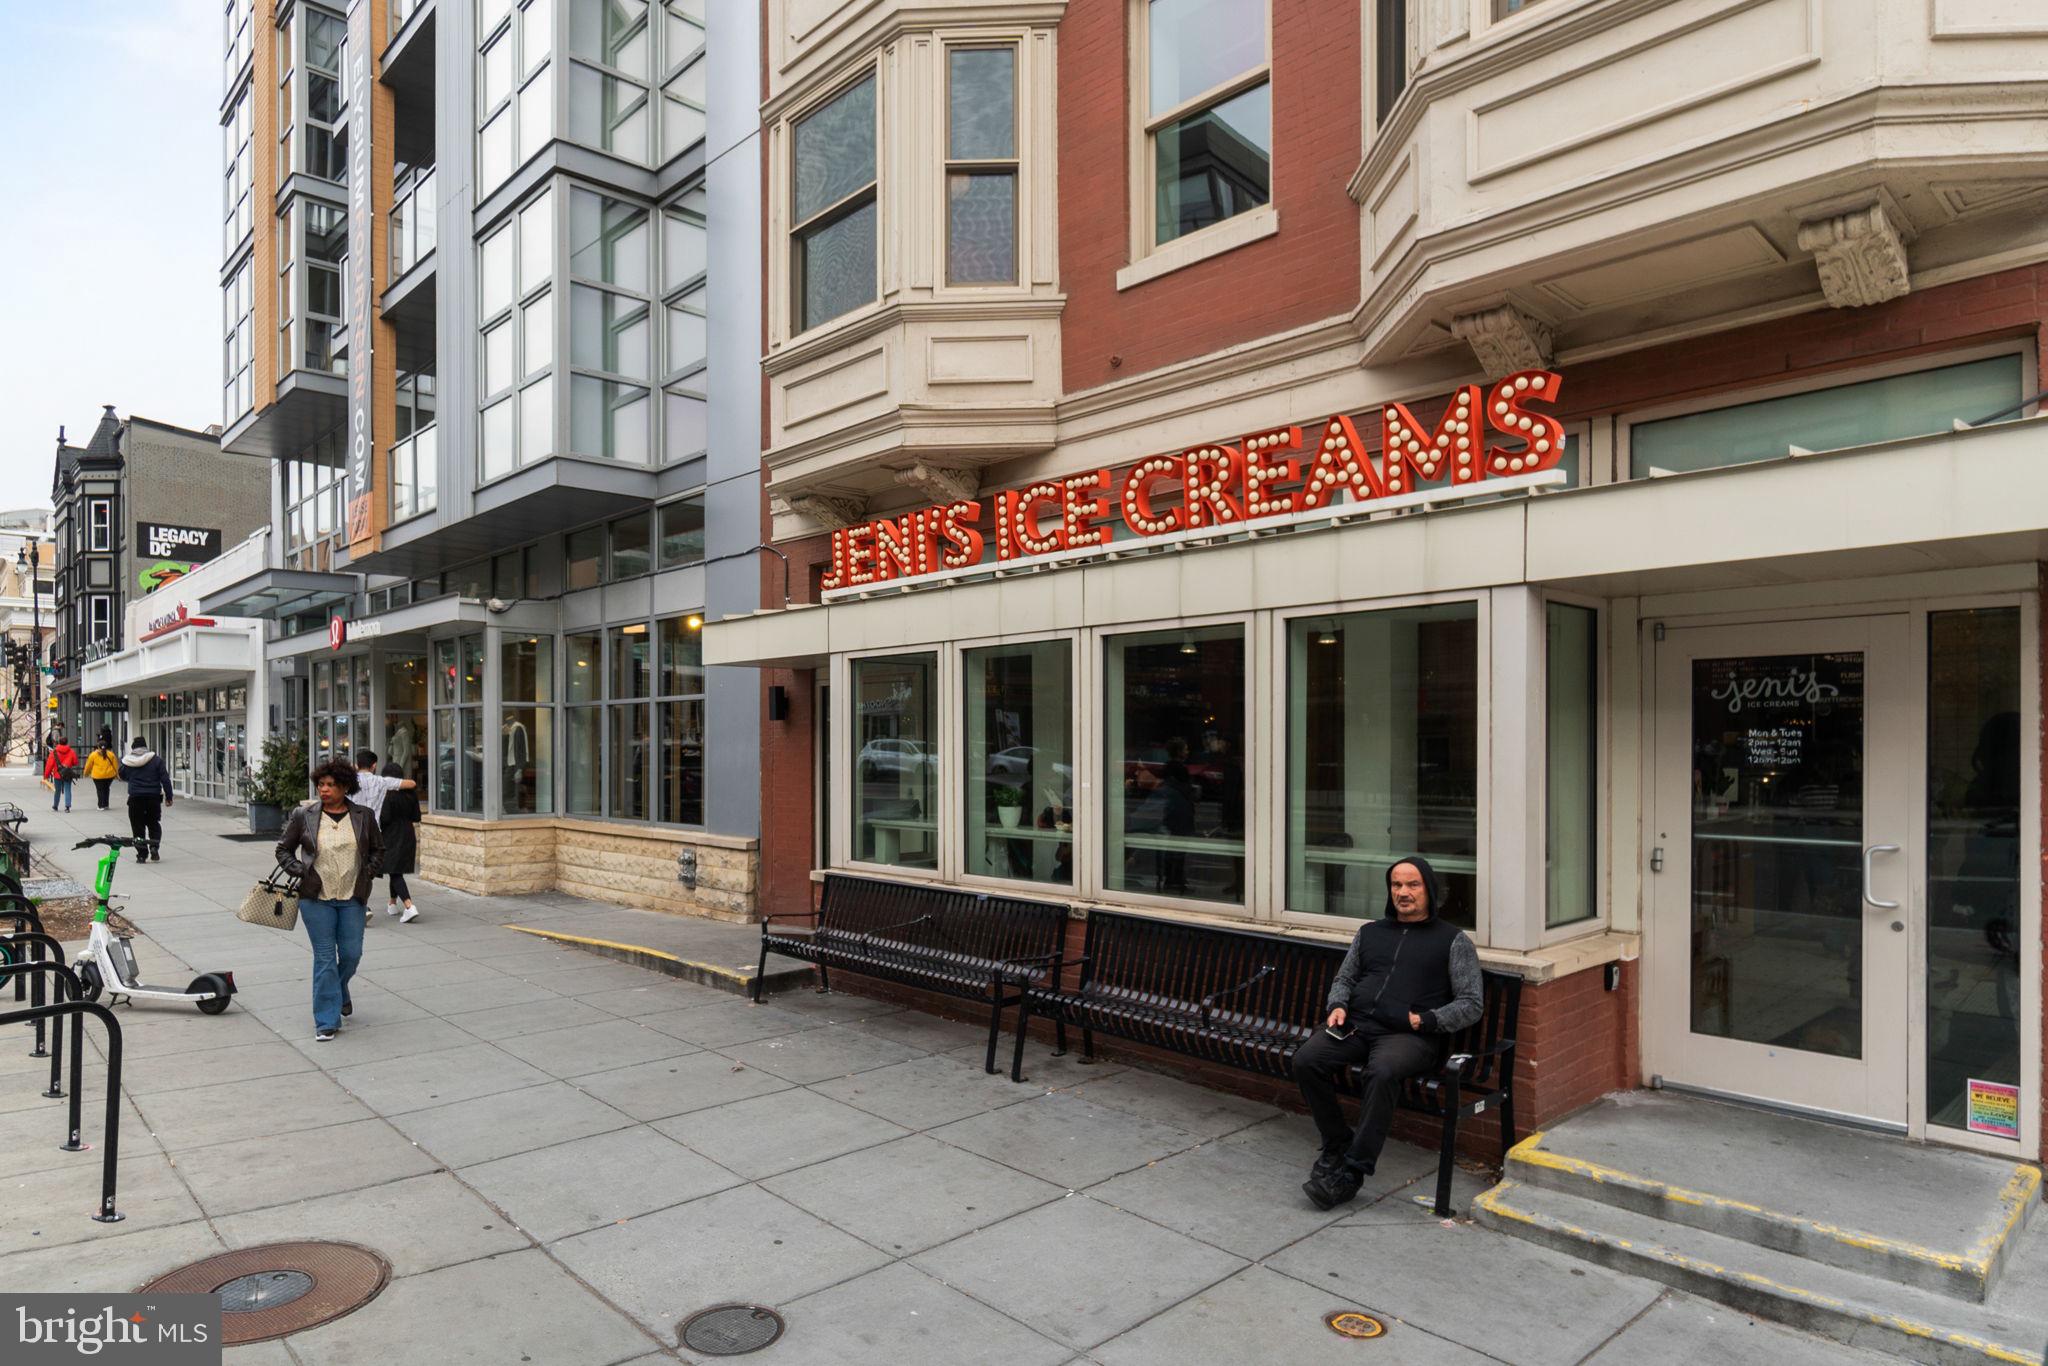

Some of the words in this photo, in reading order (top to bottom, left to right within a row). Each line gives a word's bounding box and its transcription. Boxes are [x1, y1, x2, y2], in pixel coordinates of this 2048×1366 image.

[821, 500, 983, 591] JENI'S
[994, 468, 1112, 562] ICE
[1121, 367, 1566, 538] CREAMS
[149, 526, 209, 546] LEGACY
[1711, 667, 1839, 713] jeni's
[1763, 700, 1800, 708] CREAMS
[1748, 728, 1769, 738] Mon
[1985, 1095, 2010, 1103] BELIEVE
